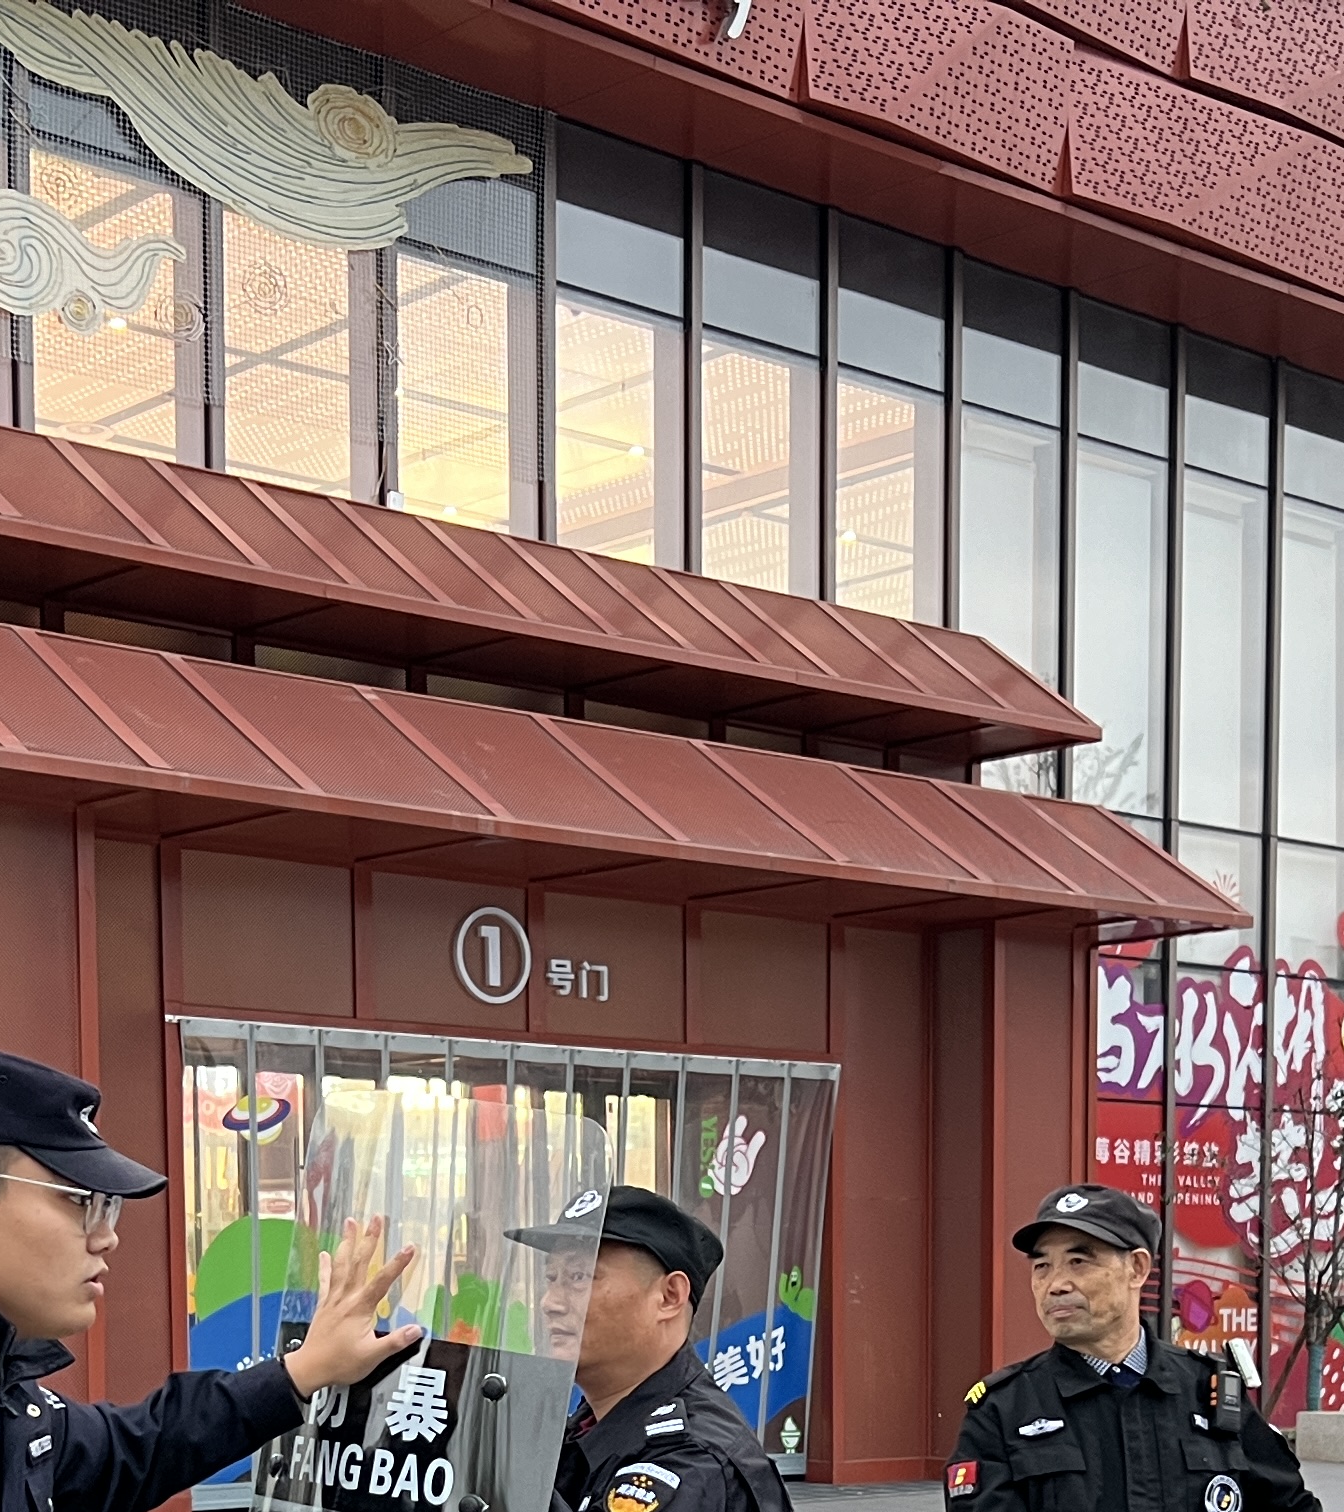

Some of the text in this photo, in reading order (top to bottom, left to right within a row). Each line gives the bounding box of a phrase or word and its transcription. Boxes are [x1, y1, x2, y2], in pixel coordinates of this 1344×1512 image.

[545, 959, 609, 1002] 号门
[1219, 1307, 1258, 1333] THE
[289, 1436, 455, 1506] FANG BAO
